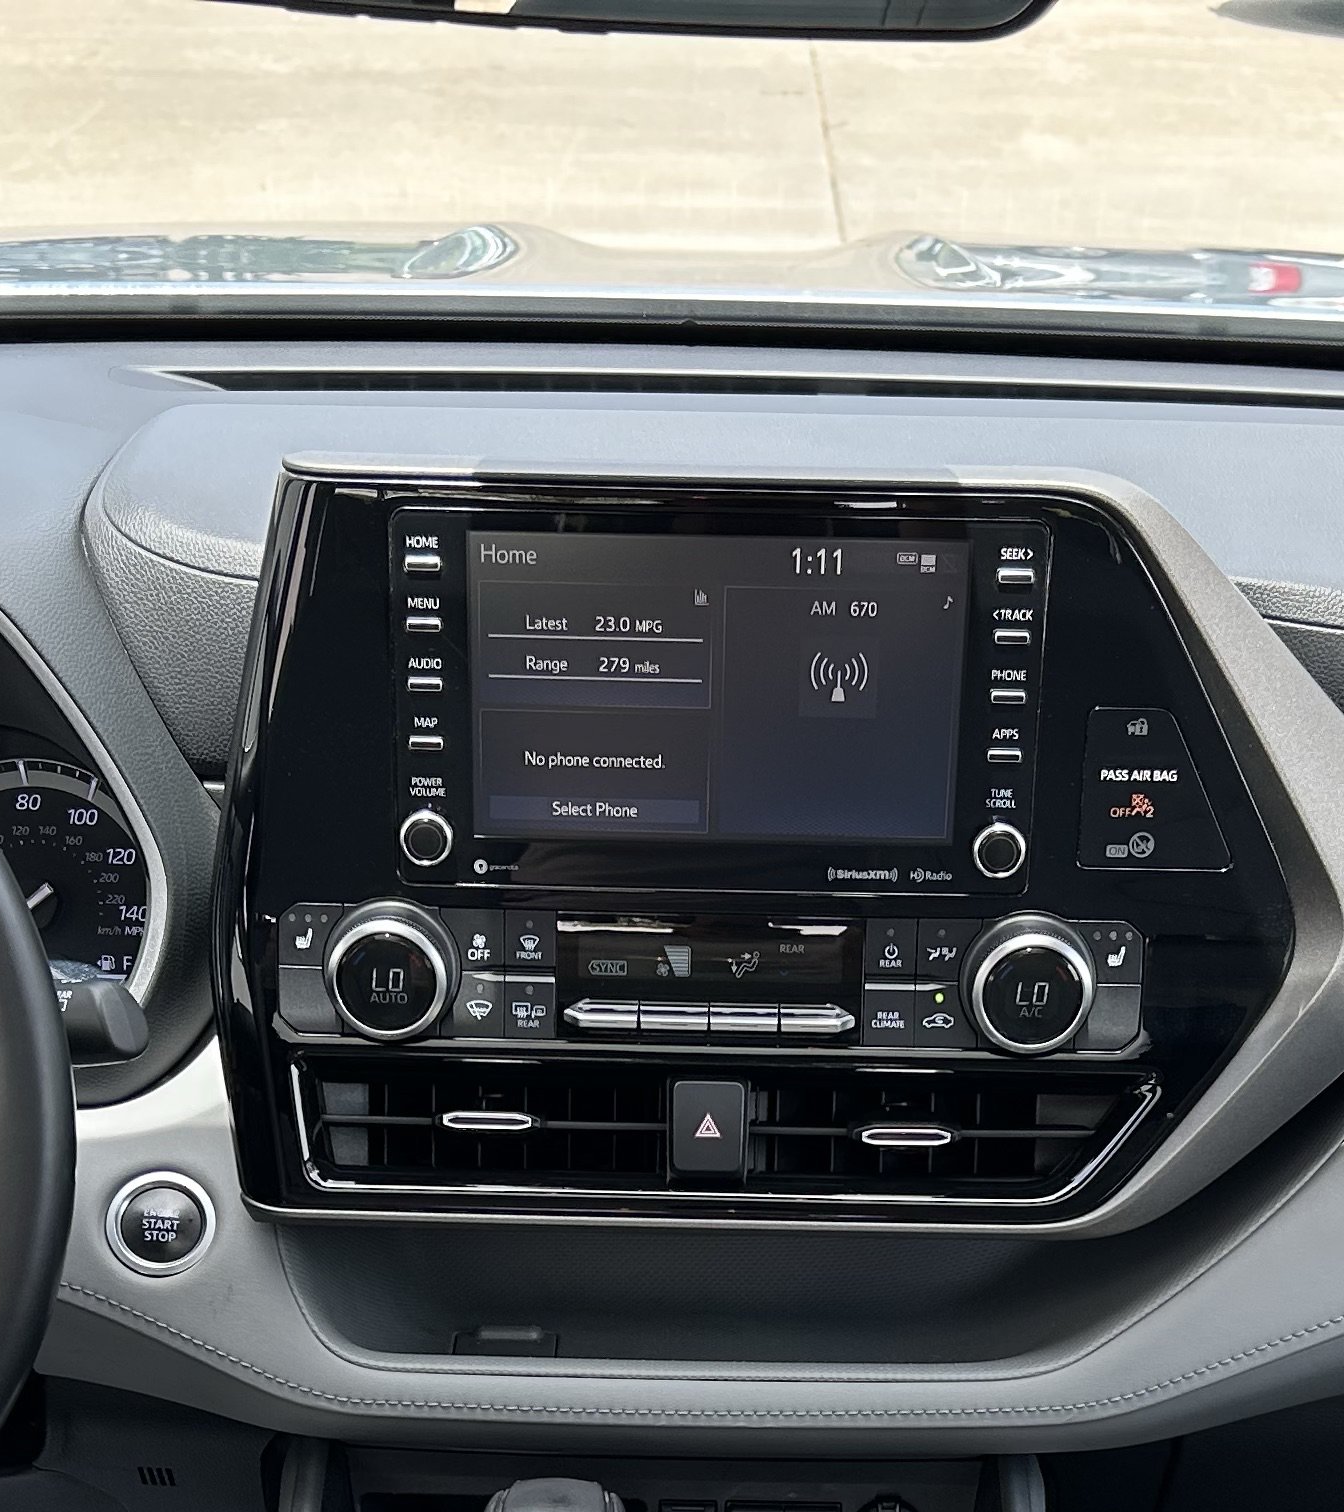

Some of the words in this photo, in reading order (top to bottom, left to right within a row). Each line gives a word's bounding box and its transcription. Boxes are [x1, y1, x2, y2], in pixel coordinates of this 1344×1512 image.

[406, 536, 438, 548] HOME
[480, 544, 537, 564] Home
[792, 548, 843, 575] 1:11
[407, 597, 440, 610] MENU
[810, 601, 836, 616] AM
[850, 601, 878, 618] 670
[526, 615, 568, 631] Latest
[594, 616, 631, 632] 23.0
[635, 620, 663, 633] MPG
[408, 658, 442, 669] AUDIO
[526, 655, 568, 673] Range
[598, 657, 630, 673] 279
[634, 661, 660, 674] miles
[991, 670, 1026, 681] PHONE
[414, 716, 438, 728] MAP
[992, 729, 1019, 740] APPS
[524, 751, 545, 766] No
[548, 752, 590, 769] phone
[592, 754, 666, 769] connected.
[1100, 770, 1128, 781] PASS
[1130, 770, 1151, 781] AIR
[1153, 770, 1178, 781] BAG
[411, 777, 442, 787] POWER
[409, 787, 446, 797] VOLUME
[991, 789, 1013, 798] TUNE
[16, 794, 41, 811] 80
[986, 799, 1016, 808] SCROLL
[552, 802, 592, 816] Select
[596, 803, 638, 818] Phone
[1110, 807, 1132, 817] OFF
[67, 809, 98, 826] 100
[12, 826, 29, 836] 120
[39, 826, 56, 836] 140
[66, 836, 82, 846] 160
[1109, 846, 1125, 855] ON
[85, 852, 103, 862] 180
[107, 849, 135, 865] 120
[99, 873, 119, 883] 200
[926, 871, 952, 880] Radio
[106, 895, 125, 904] 220
[779, 944, 804, 953] REAR
[467, 949, 491, 961] OFF
[516, 951, 542, 960] FRONT
[123, 956, 132, 970] F
[591, 962, 625, 974] SYNC
[879, 959, 902, 968] REAR
[372, 968, 404, 992] LO
[370, 992, 407, 1004] AUTO
[1016, 982, 1049, 1005] LO
[877, 1012, 899, 1020] REAR
[1019, 1007, 1043, 1018] A/C
[517, 1019, 539, 1028] REAR
[871, 1020, 904, 1029] CLIMATE
[142, 1219, 180, 1230] START
[144, 1230, 176, 1242] STOP
